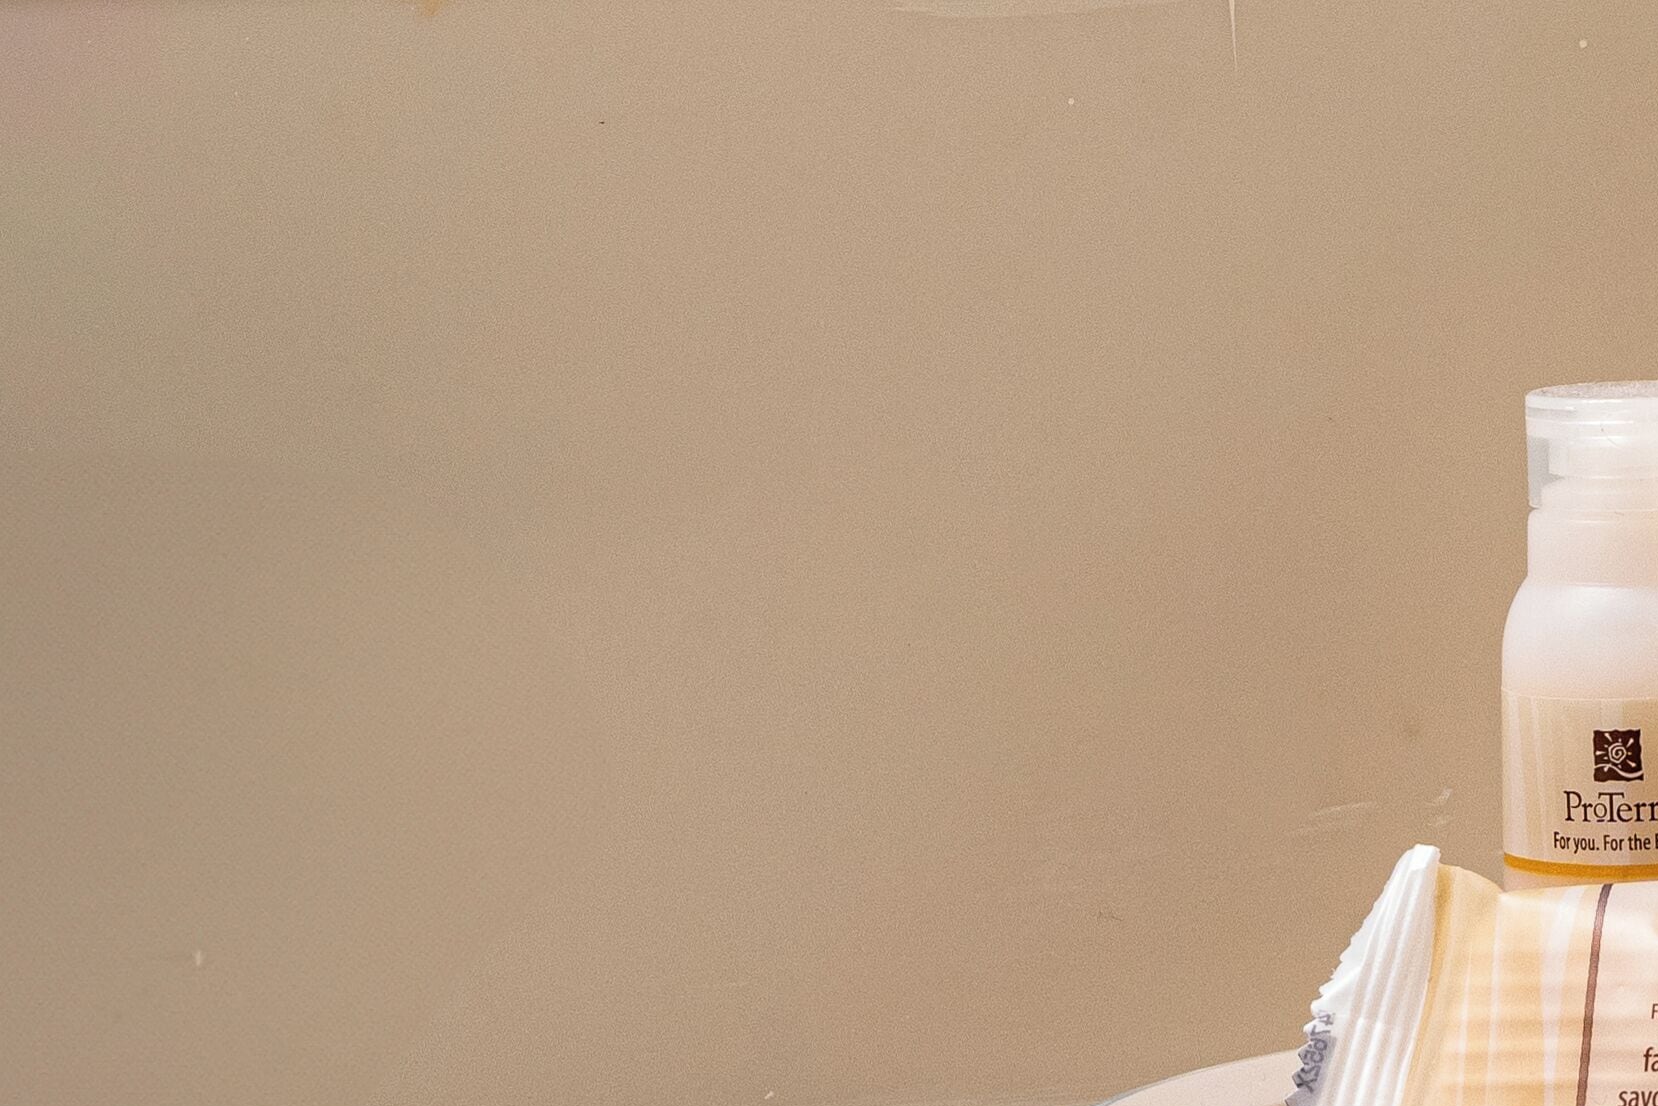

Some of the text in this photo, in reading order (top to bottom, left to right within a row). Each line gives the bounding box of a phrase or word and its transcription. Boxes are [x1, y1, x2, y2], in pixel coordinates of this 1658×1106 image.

[1553, 831, 1571, 850] For
[1573, 836, 1600, 854] you.
[1603, 834, 1626, 852] For
[1628, 834, 1651, 851] the
